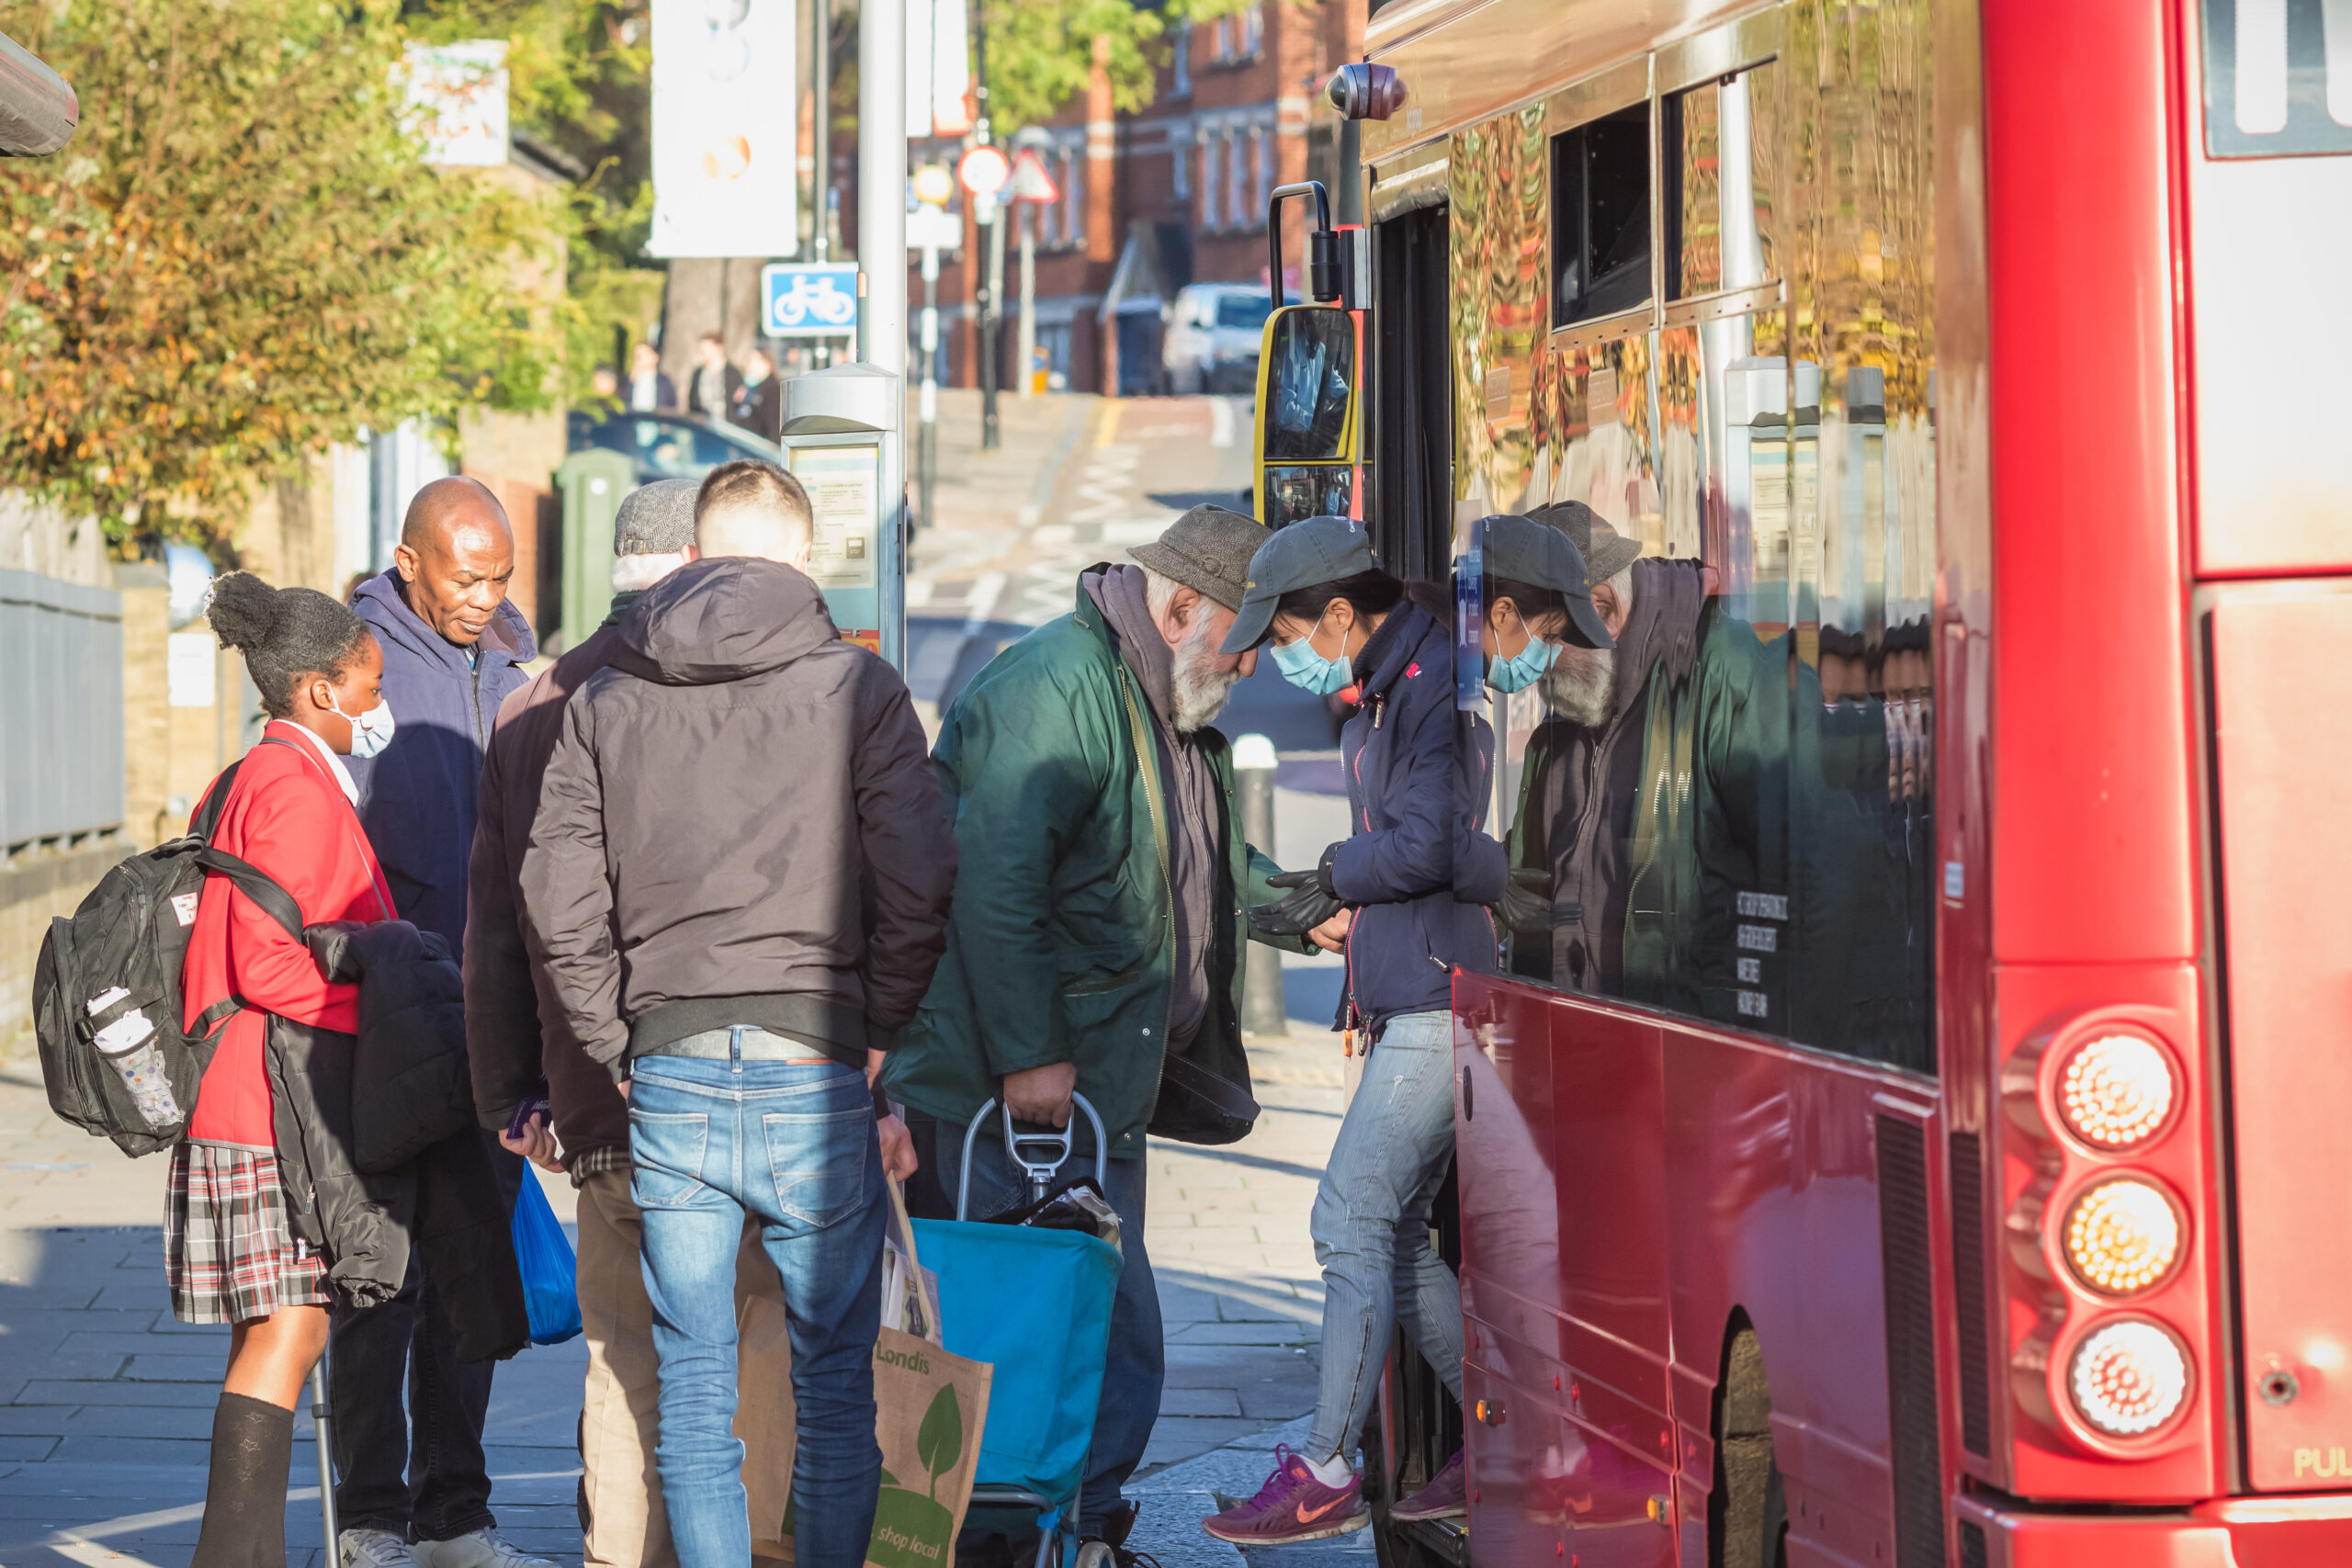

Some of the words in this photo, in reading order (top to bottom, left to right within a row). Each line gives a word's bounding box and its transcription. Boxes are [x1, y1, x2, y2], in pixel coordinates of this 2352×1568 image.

[876, 1339, 930, 1375] Londis
[877, 1525, 909, 1552] shop
[909, 1535, 942, 1560] local
